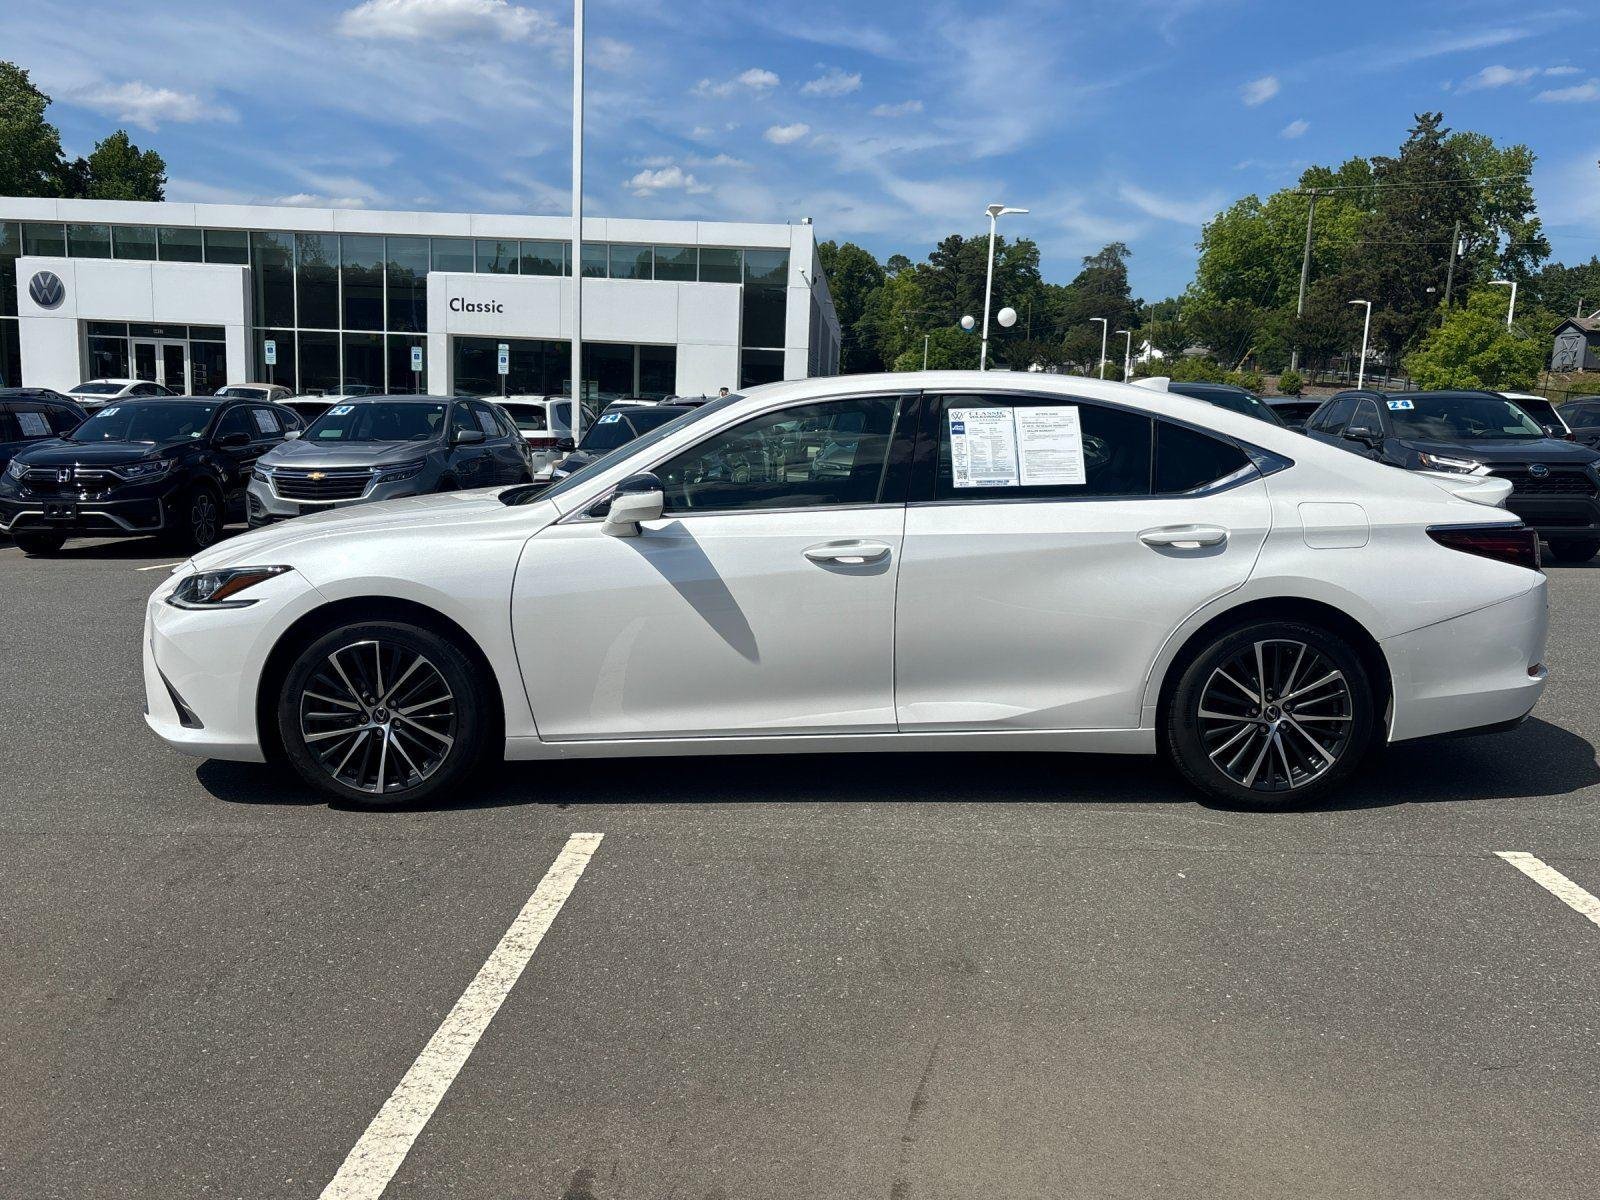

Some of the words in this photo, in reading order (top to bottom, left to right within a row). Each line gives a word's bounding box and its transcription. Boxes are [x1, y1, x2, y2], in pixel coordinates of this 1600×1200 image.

[29, 270, 64, 309] VW
[449, 297, 504, 313] Classic
[1389, 399, 1410, 409] 24
